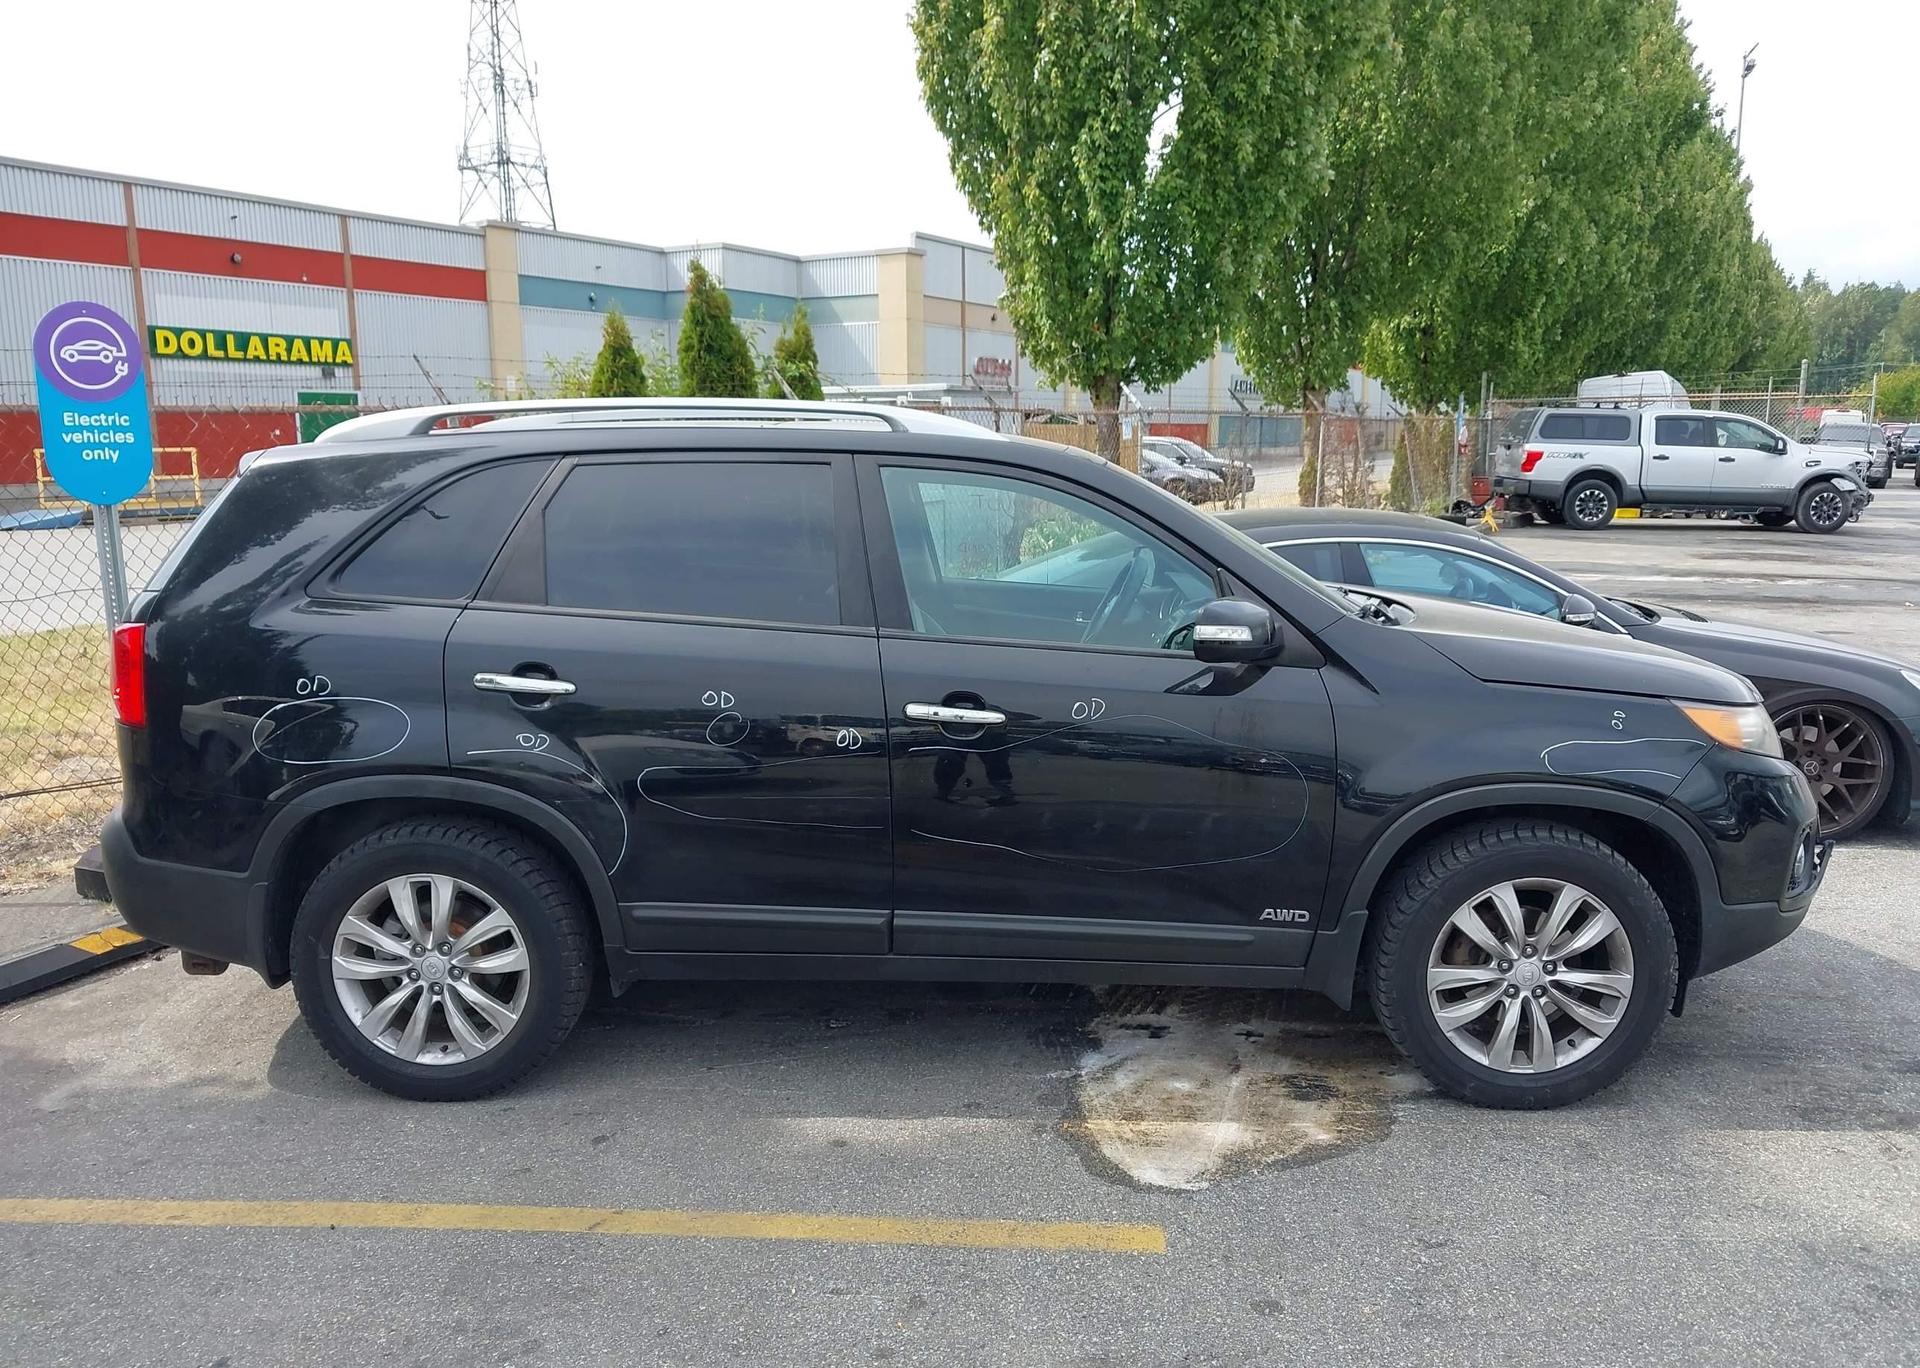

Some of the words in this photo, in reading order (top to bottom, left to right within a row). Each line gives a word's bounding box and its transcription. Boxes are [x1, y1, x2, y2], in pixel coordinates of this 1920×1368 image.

[155, 329, 353, 363] DOLLARAMA
[63, 412, 130, 426] Electric
[62, 429, 135, 443] vehicles
[82, 447, 120, 463] only
[296, 675, 332, 695] OD
[702, 690, 735, 708] OD
[1071, 698, 1106, 720] OD
[516, 733, 550, 751] OD
[836, 728, 862, 749] OD
[1259, 909, 1310, 922] AWD
